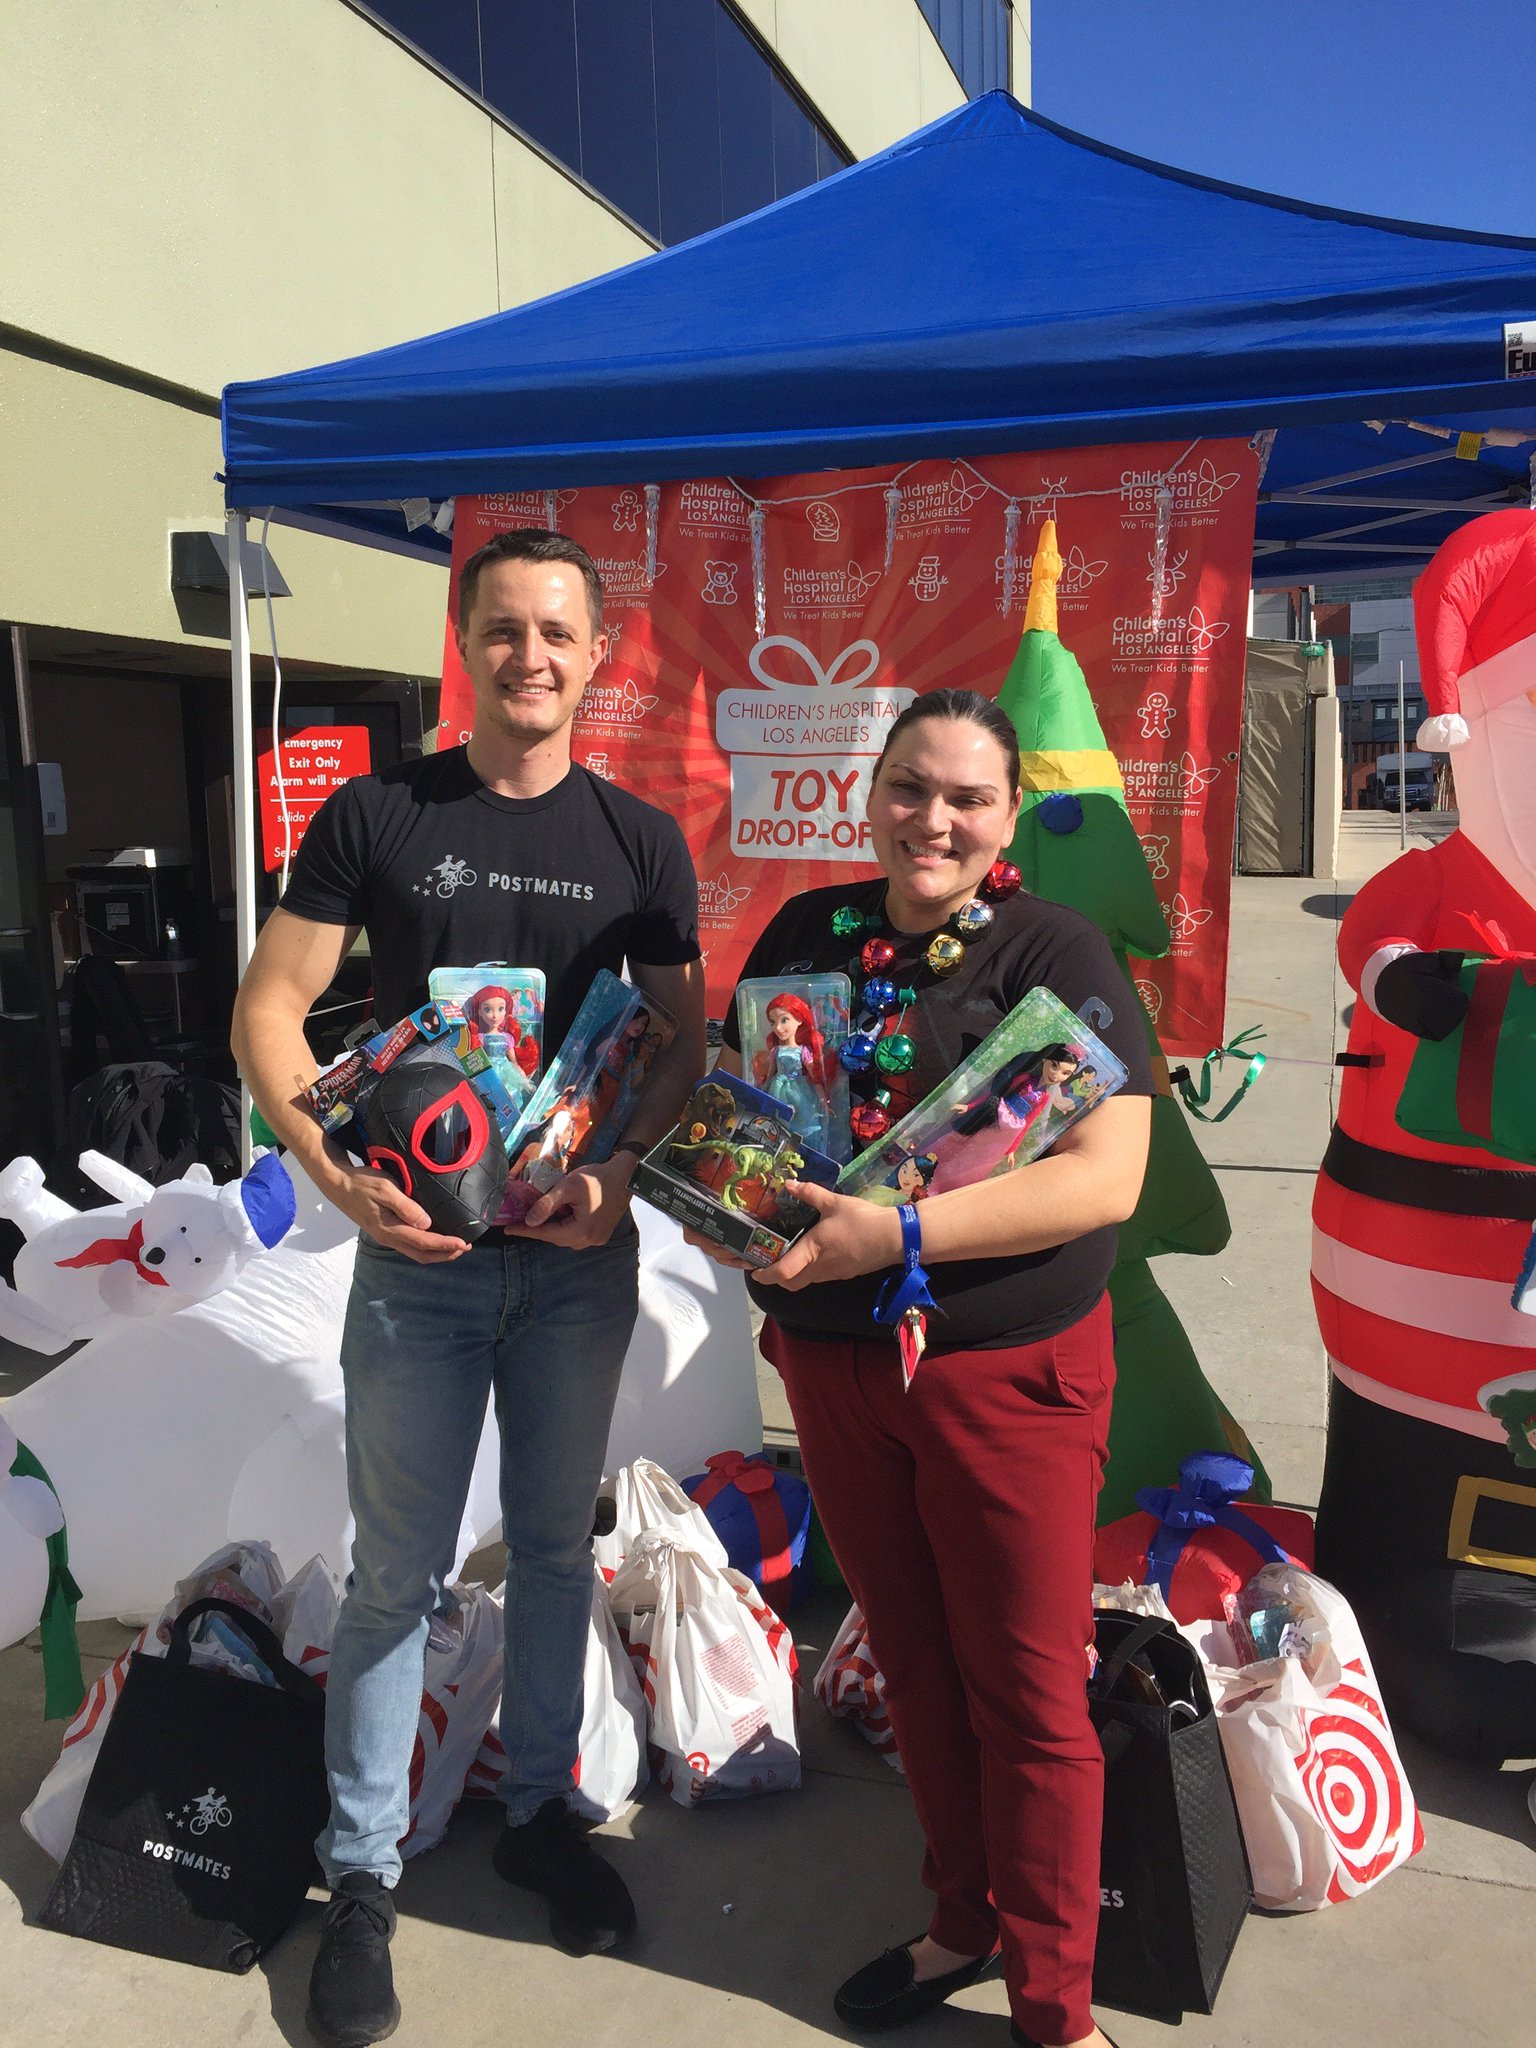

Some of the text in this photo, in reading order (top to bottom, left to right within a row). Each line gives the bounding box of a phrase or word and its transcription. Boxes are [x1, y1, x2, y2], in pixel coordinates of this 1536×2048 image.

[1120, 469, 1198, 486] Childen's
[884, 480, 949, 502] ildren's
[484, 501, 548, 518] LOS ANGELE
[680, 496, 745, 515] Hospital
[887, 492, 946, 515] ospital
[1129, 500, 1152, 511] LOS
[687, 510, 752, 526] LOS ANGELE
[919, 506, 960, 520] ANGELES
[680, 527, 694, 538] We
[697, 528, 718, 539] Treat
[944, 524, 971, 534] Better
[1120, 520, 1137, 530] We
[592, 557, 637, 571] ildren's
[598, 570, 633, 588] spital
[783, 567, 847, 581] Children's
[783, 580, 845, 598] Hospital
[790, 594, 811, 604] LOS
[1113, 615, 1187, 632] Childen's
[1112, 628, 1182, 649] Hospital
[1120, 645, 1142, 656] LOS
[1112, 663, 1209, 673] We Treat Kids Better
[584, 684, 623, 699] dren's
[577, 698, 619, 714] spital
[727, 702, 825, 721] CHILDREN'S
[596, 727, 615, 737] Kids
[618, 729, 642, 739] Better
[763, 725, 870, 744] LOS ANGELES
[288, 756, 341, 770] Exit Only
[1116, 758, 1179, 774] hildren's
[270, 775, 303, 787] Aarm
[307, 774, 327, 786] will
[770, 769, 860, 813] TOY
[1128, 806, 1200, 817] reat Kids Better
[736, 819, 873, 849] DROP-OF
[489, 872, 595, 901] POSTMATES
[698, 904, 726, 914] GELES
[142, 1839, 232, 1880] POSTMATES
